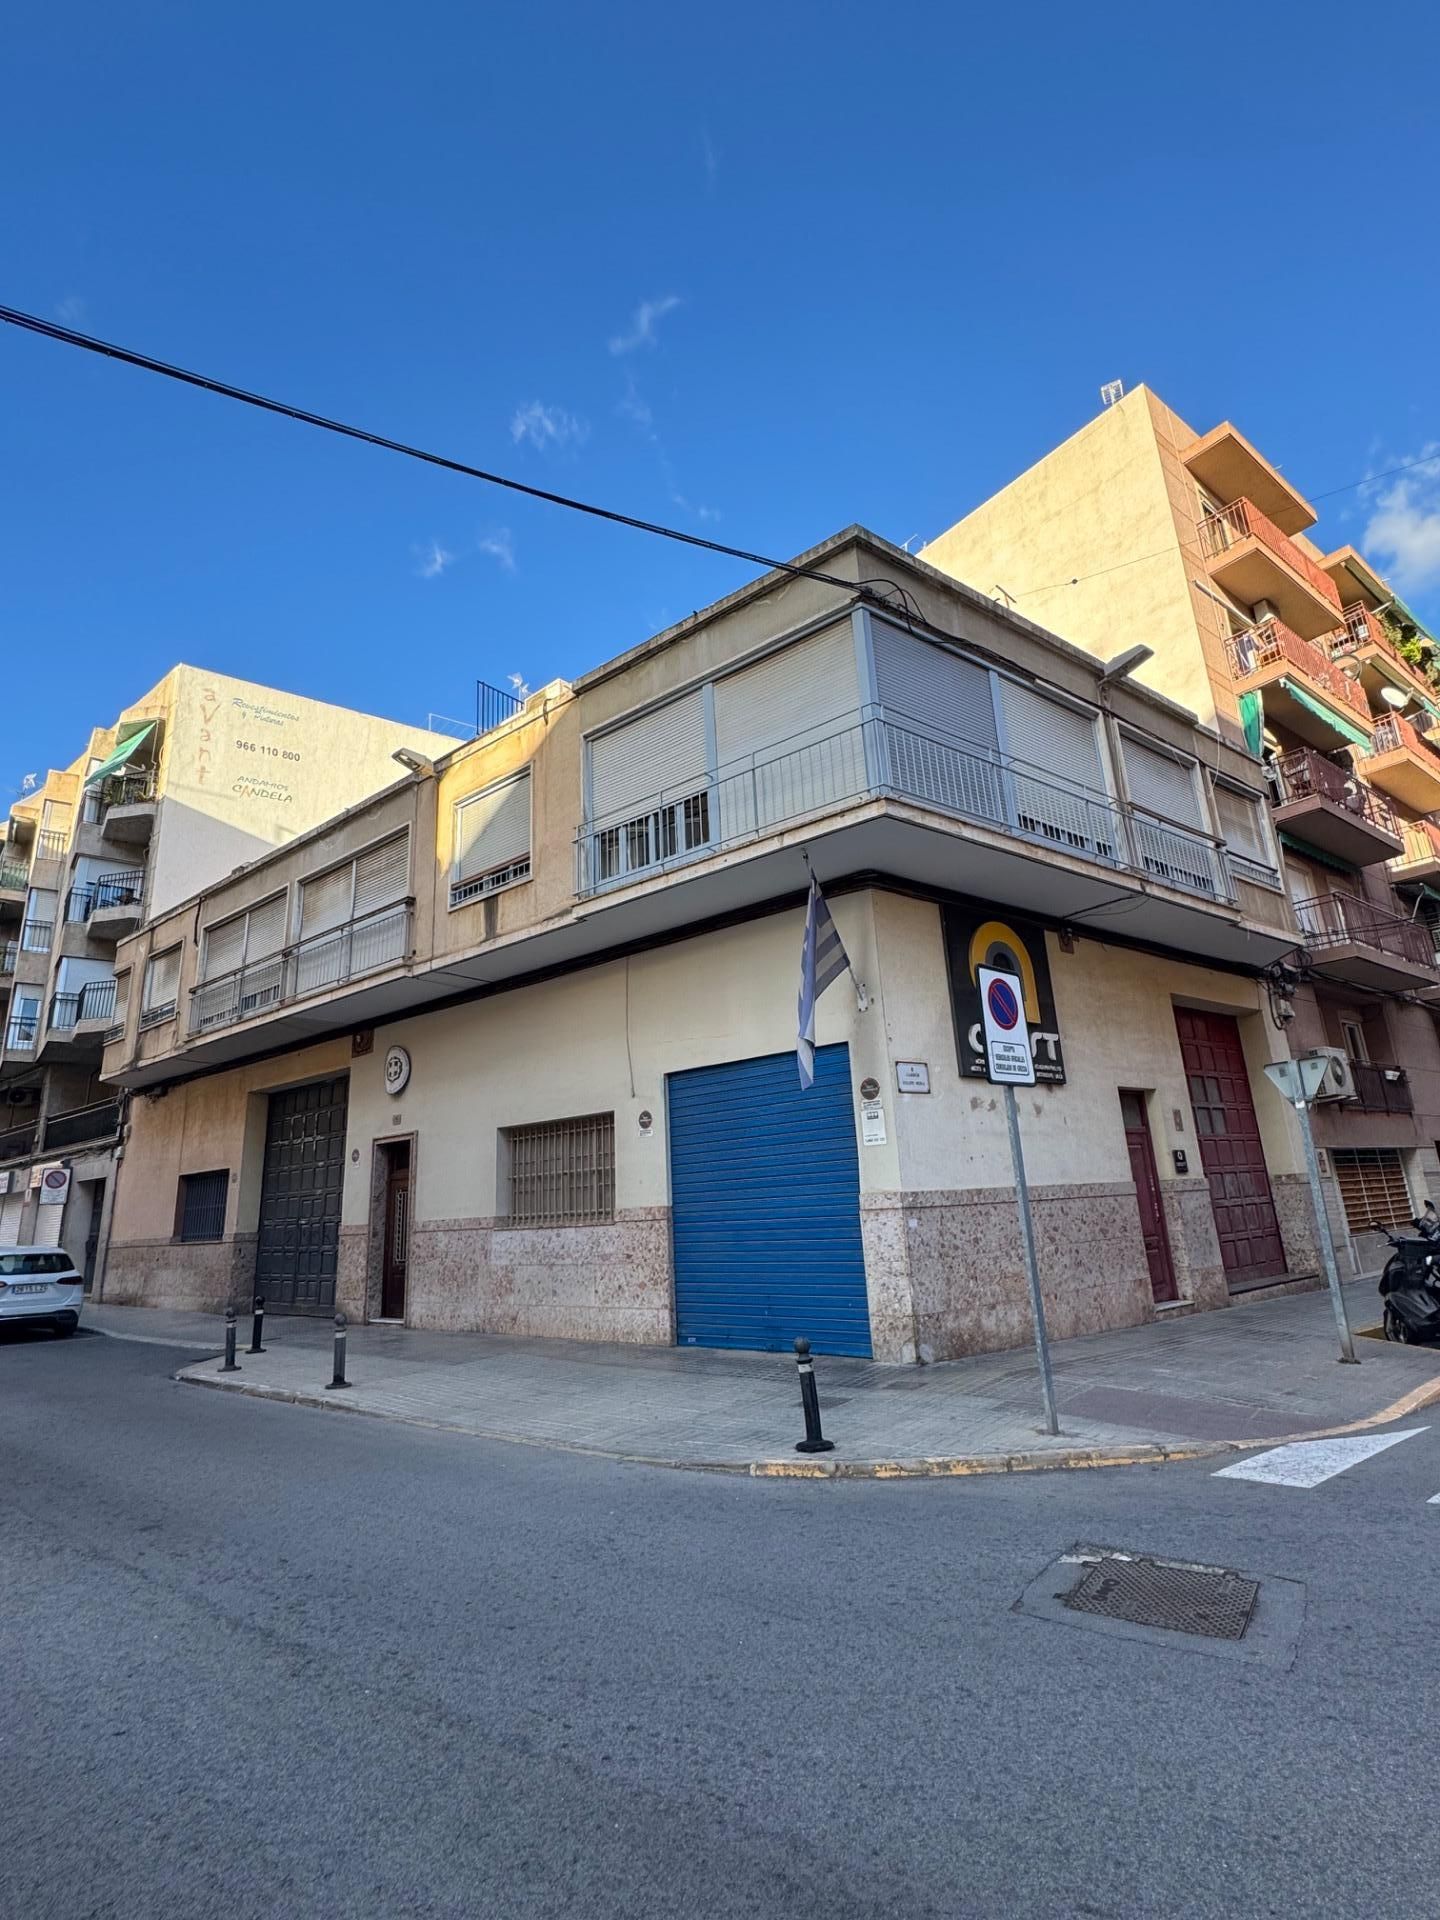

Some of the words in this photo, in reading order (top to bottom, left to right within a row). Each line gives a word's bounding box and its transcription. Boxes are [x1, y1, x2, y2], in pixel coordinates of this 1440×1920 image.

[235, 740, 256, 752] 966
[260, 746, 278, 757] 110
[282, 750, 301, 762] 800
[237, 775, 289, 791] ANDAMIOS
[232, 784, 293, 803] CANDELA
